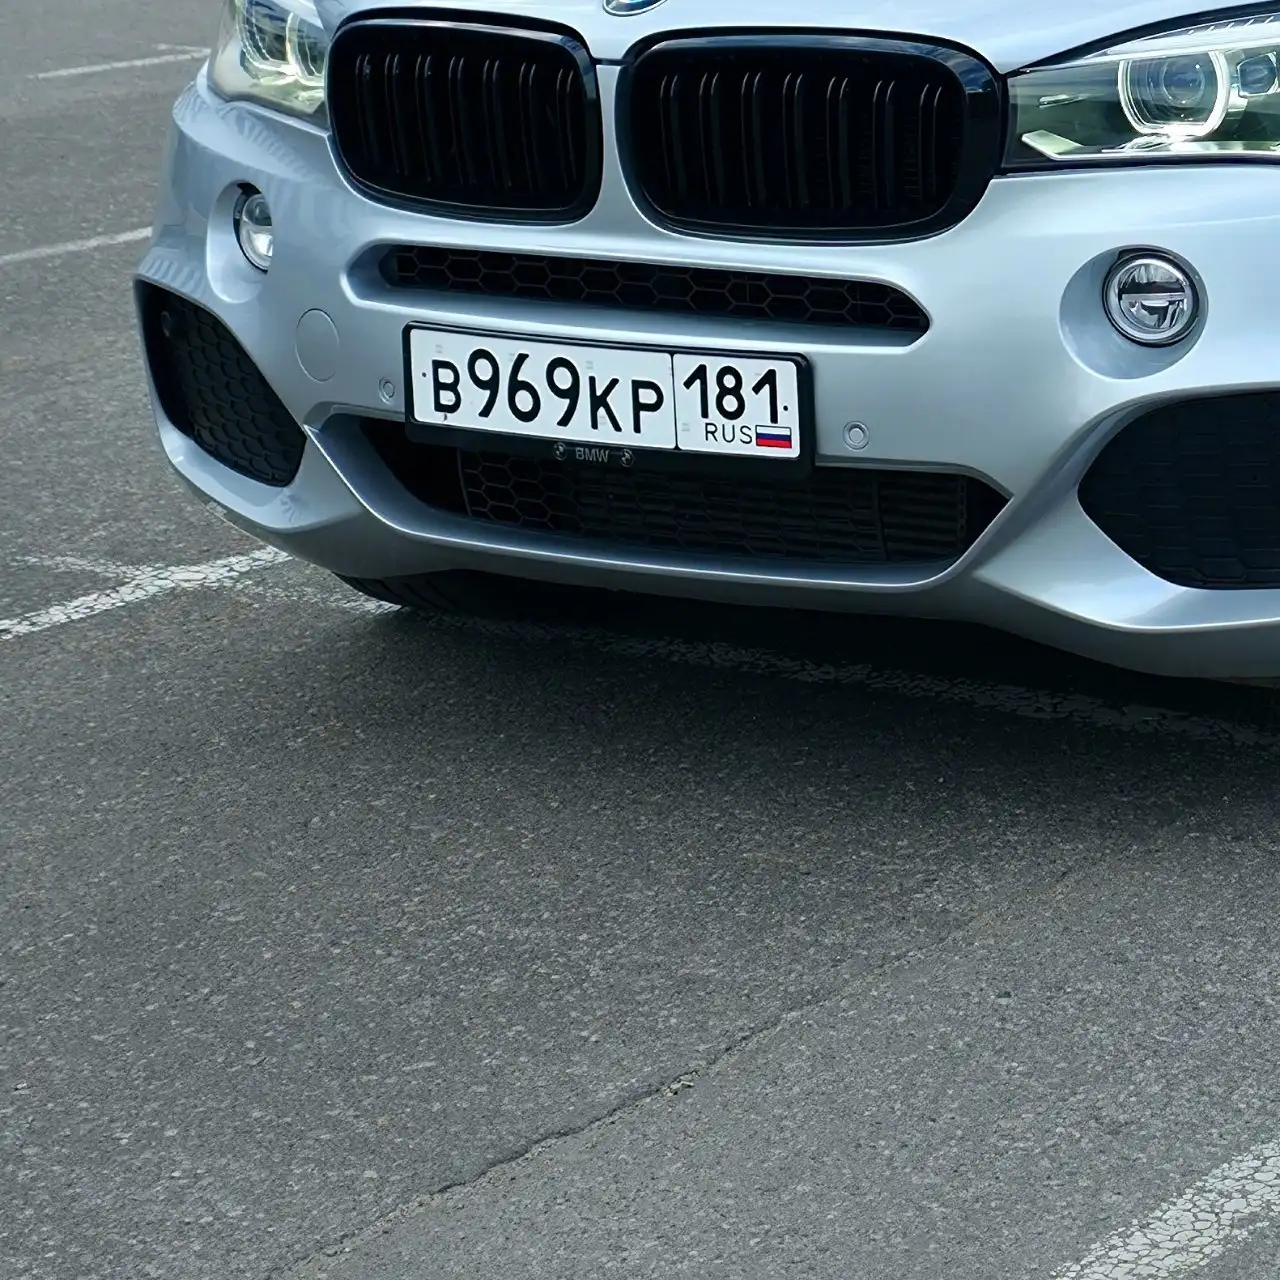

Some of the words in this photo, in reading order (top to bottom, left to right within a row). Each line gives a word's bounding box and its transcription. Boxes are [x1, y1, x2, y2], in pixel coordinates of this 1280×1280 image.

[682, 363, 780, 425] 181
[704, 422, 753, 445] RUS
[575, 446, 611, 463] BMW
